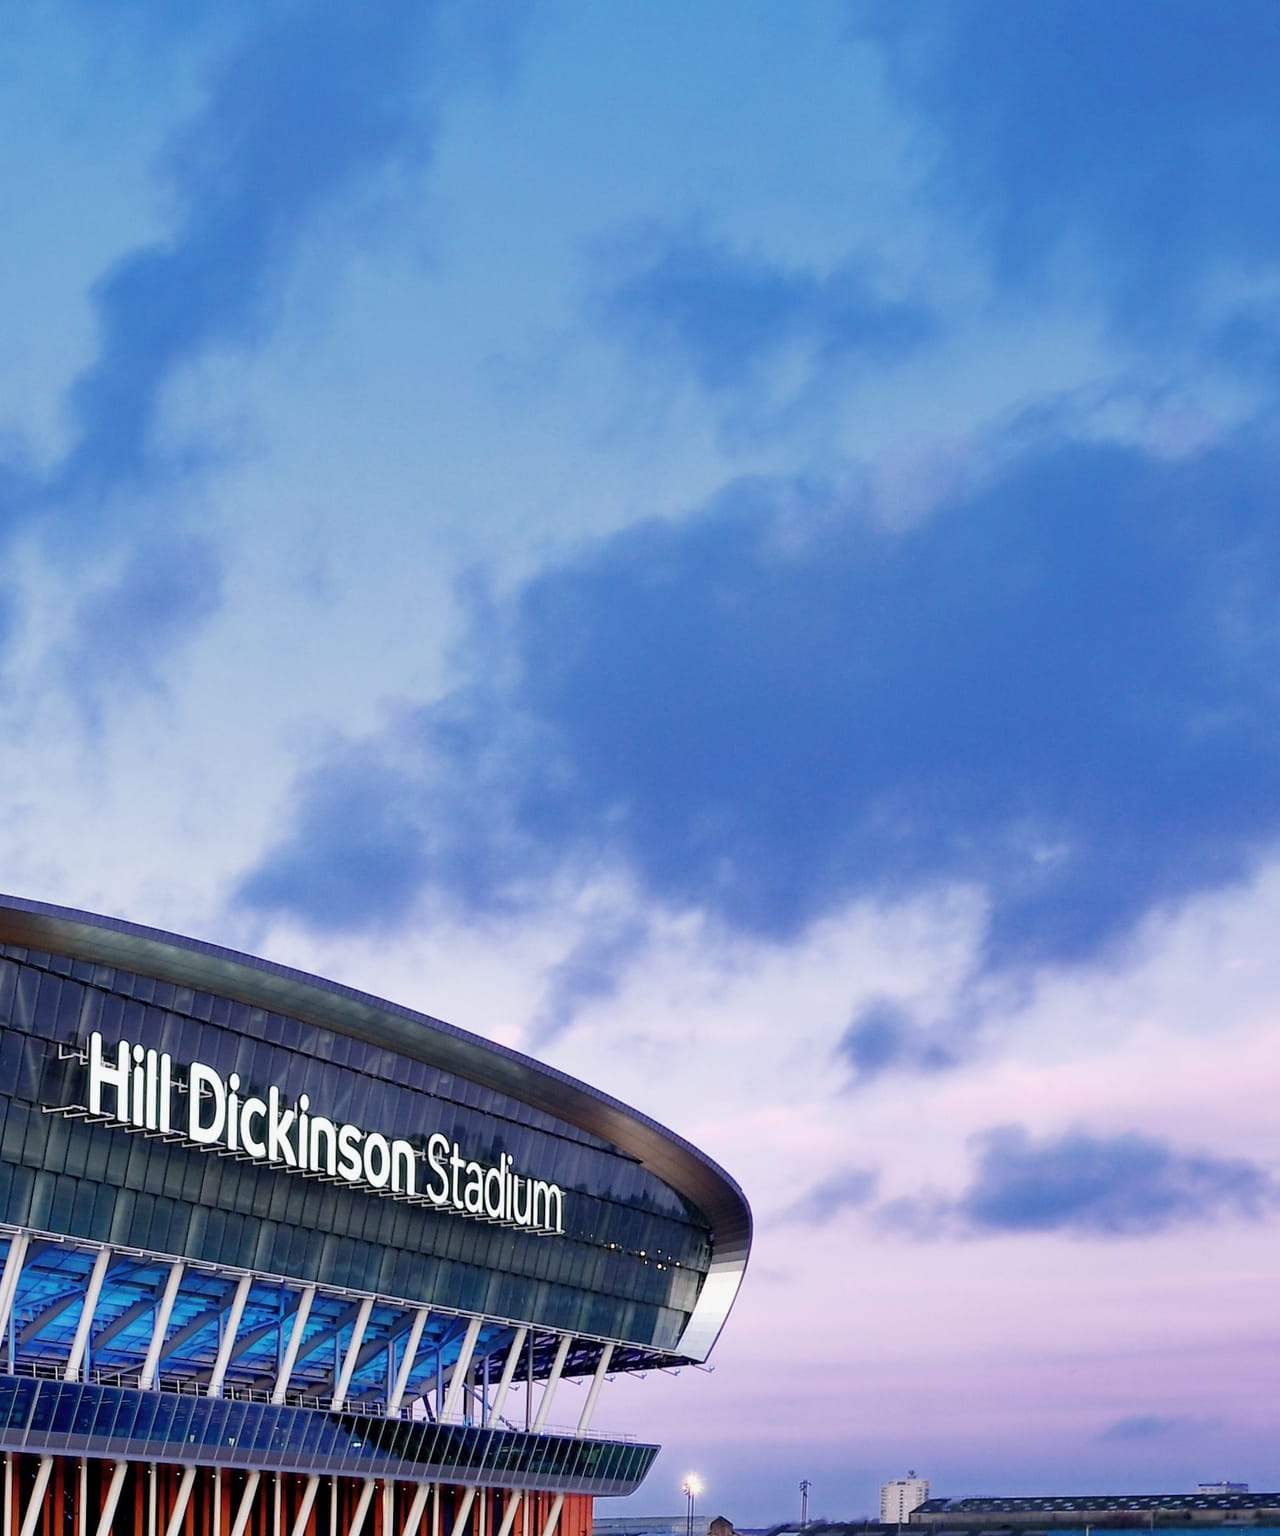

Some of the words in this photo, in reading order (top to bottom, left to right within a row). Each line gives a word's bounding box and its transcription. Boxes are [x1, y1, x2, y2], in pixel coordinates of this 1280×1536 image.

[87, 1031, 172, 1133] Hill
[188, 1061, 417, 1196] Dickinson
[425, 1132, 565, 1233] Stadium
